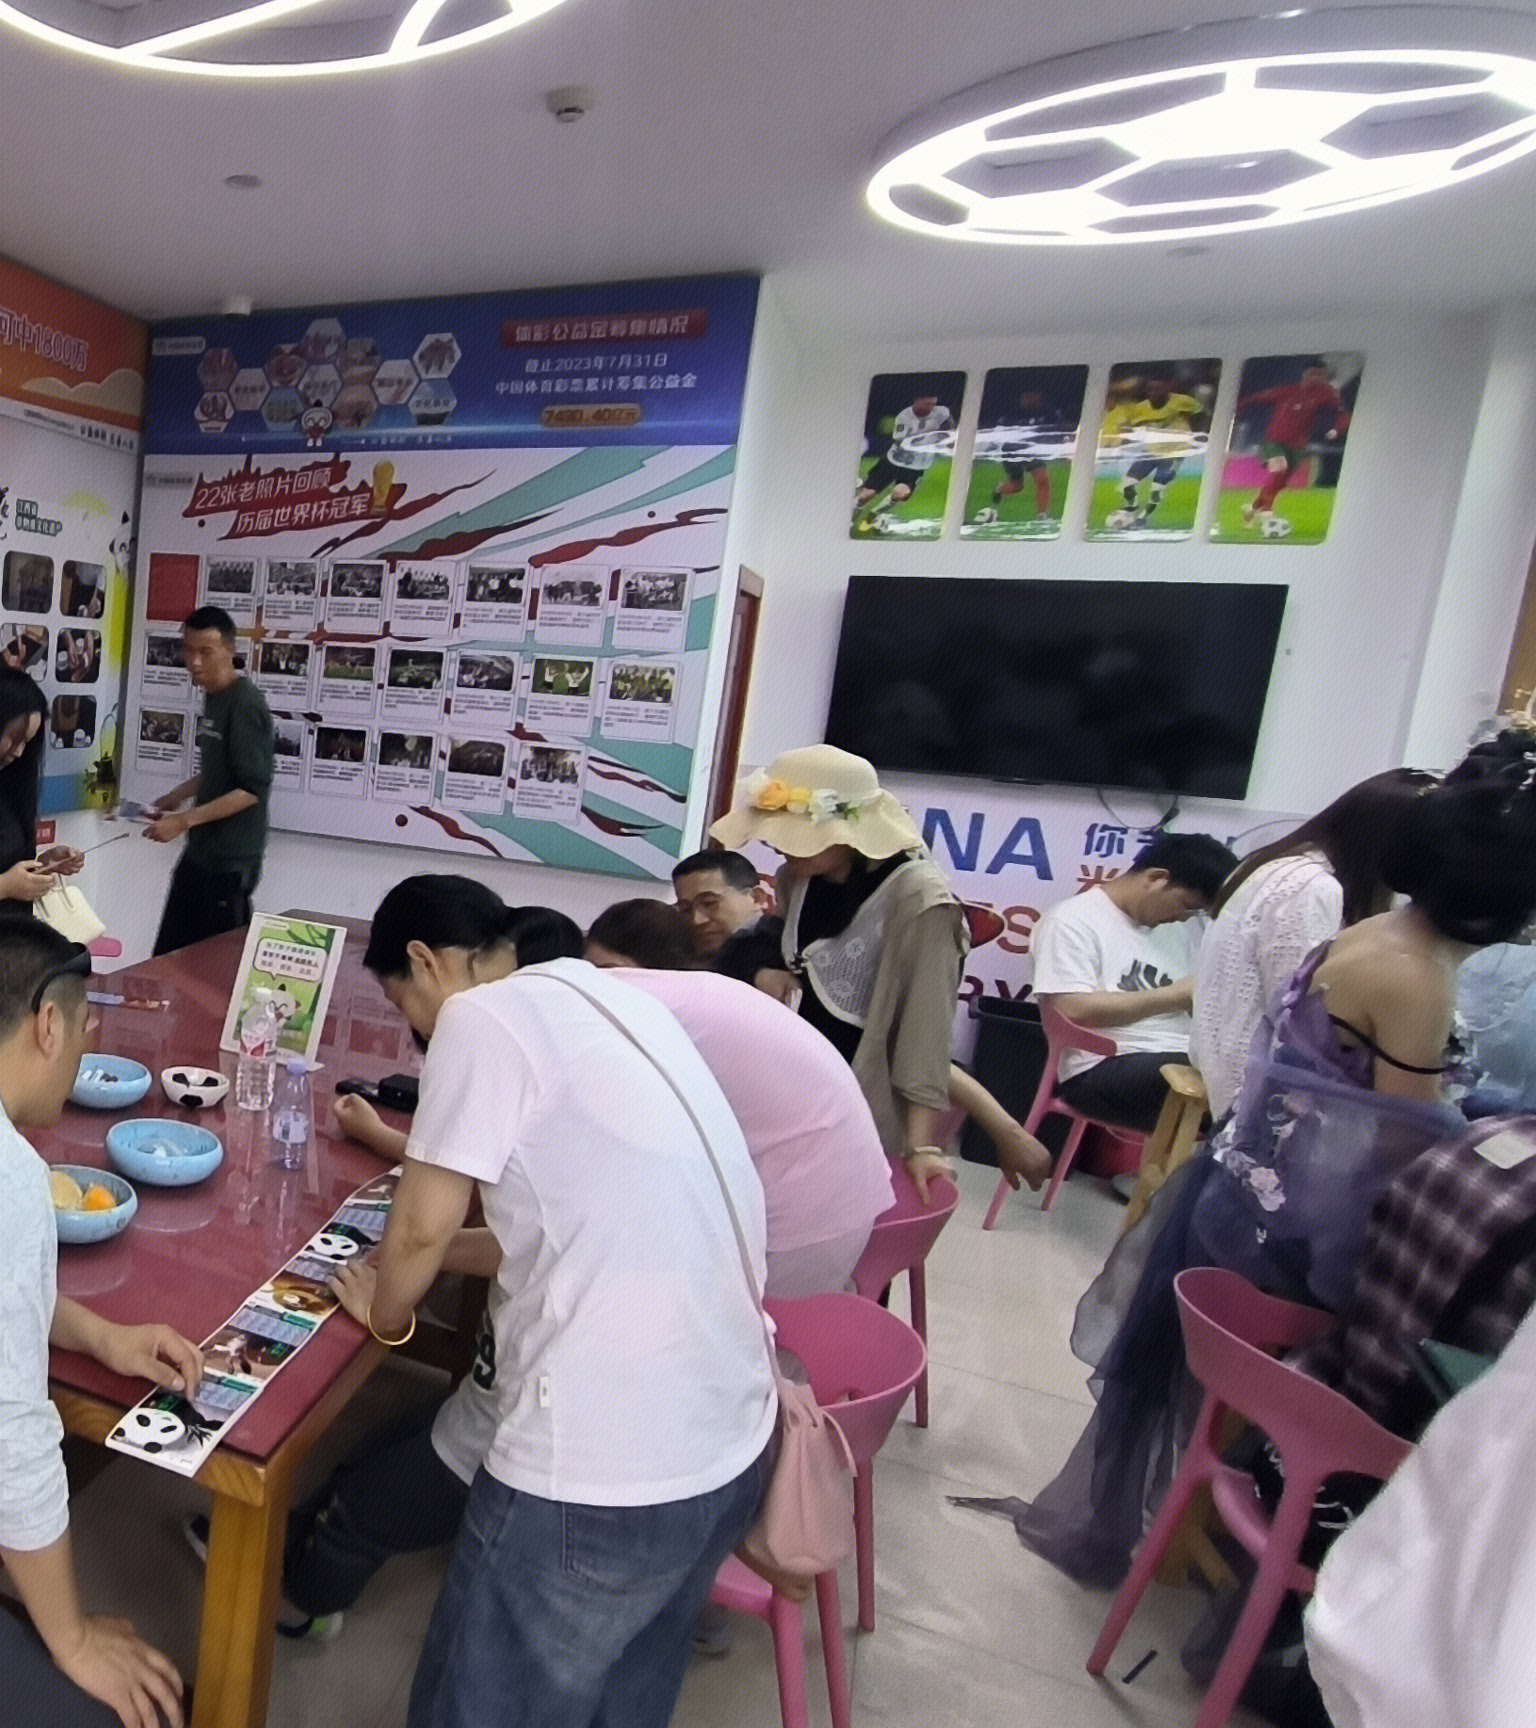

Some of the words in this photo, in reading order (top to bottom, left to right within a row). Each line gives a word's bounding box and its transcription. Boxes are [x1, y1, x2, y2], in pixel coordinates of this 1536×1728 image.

[195, 467, 333, 510] 22张老照片回顾
[237, 492, 371, 533] 历届世界杯冠军
